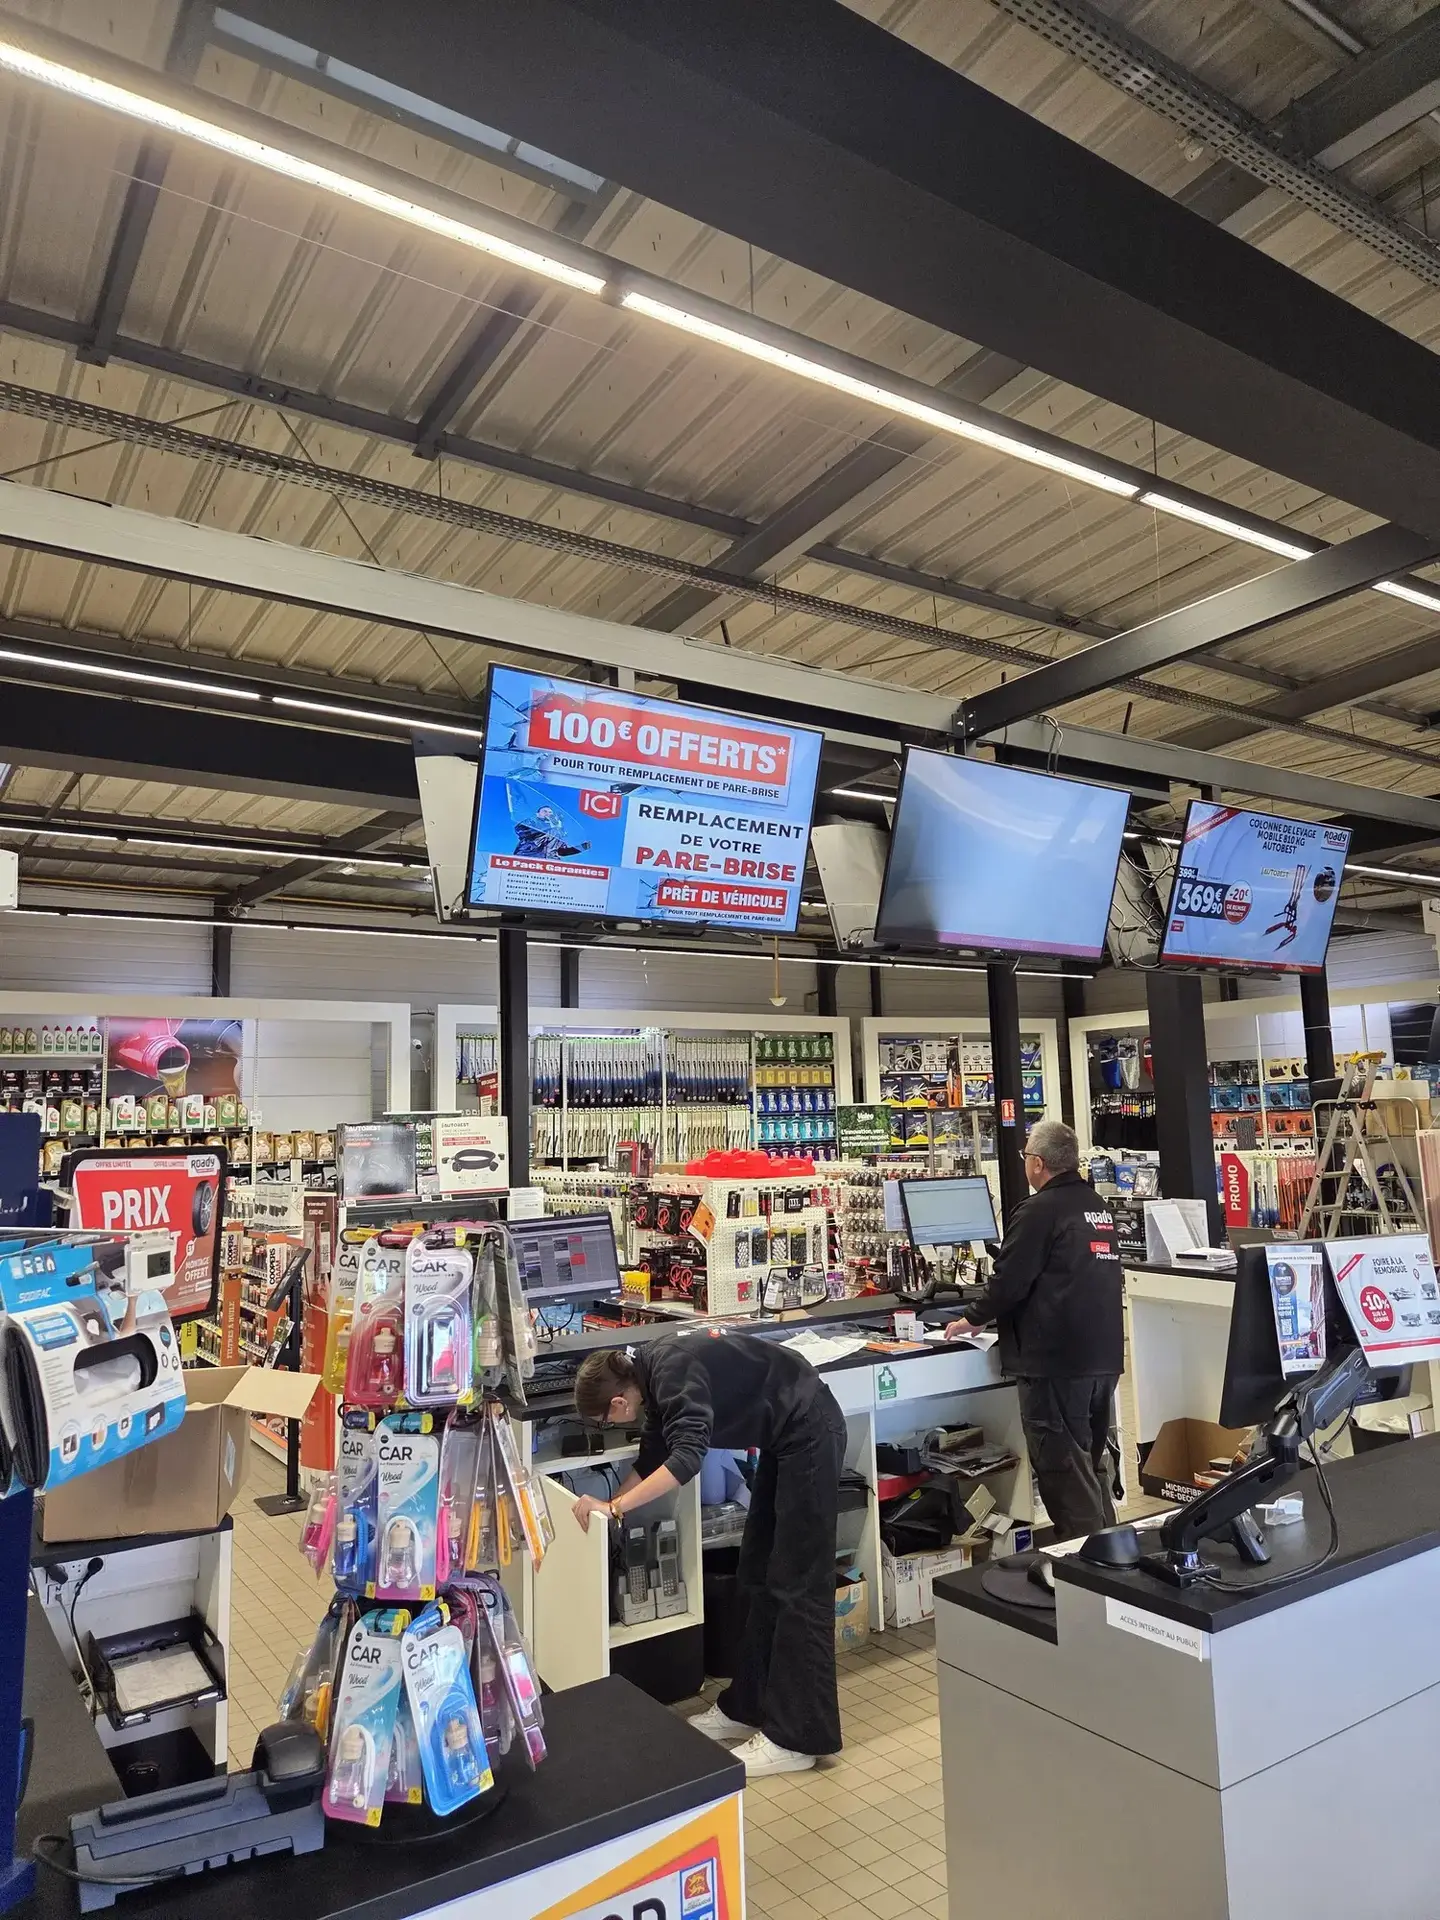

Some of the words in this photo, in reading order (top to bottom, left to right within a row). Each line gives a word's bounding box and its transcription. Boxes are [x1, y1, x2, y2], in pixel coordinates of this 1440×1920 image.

[544, 708, 633, 748] 100€
[553, 756, 584, 771] POUR
[587, 760, 616, 775] TOUT
[618, 766, 704, 788] REMPLACEMENT
[707, 778, 720, 790] DE
[722, 781, 780, 799] PARE-BRISE
[584, 793, 618, 815] ICI
[638, 804, 804, 840] REMPLACEMENT
[1250, 818, 1283, 834] COLONNE
[1284, 825, 1292, 834] DE
[1292, 826, 1317, 839] LEVAGE
[680, 833, 704, 848] DE
[709, 838, 762, 854] VOTRE
[1257, 830, 1284, 843] MOBILE
[1284, 834, 1295, 844] 810
[1296, 837, 1306, 846] KG
[1262, 842, 1298, 854] AUTOBEST
[496, 858, 510, 867] Le
[512, 860, 544, 870] Pack
[546, 864, 605, 877] Garanties
[636, 846, 796, 882] PARE-BRISE
[662, 885, 698, 902] PRÊT
[702, 890, 719, 904] DE
[722, 890, 783, 909] VÉHICULE
[700, 911, 742, 920] REMPLACEMENT
[1228, 1164, 1241, 1210] PROMO
[102, 1185, 172, 1230] PRIX
[1084, 1210, 1113, 1227] Roady
[340, 1254, 359, 1268] CA
[364, 1260, 400, 1273] CAR
[412, 1260, 447, 1273] CAR
[1372, 1257, 1390, 1266] FOIRE
[184, 1266, 209, 1282] OFFERT
[1374, 1266, 1408, 1274] REMORQUE
[1362, 1294, 1390, 1310] -10%
[342, 1440, 364, 1456] CAR
[379, 1446, 413, 1460] CAR
[380, 1470, 403, 1482] Wood
[1120, 1615, 1138, 1626] ACCES
[1139, 1622, 1165, 1636] INTERDIT
[1176, 1636, 1198, 1649] PUBLIC
[351, 1645, 382, 1664] CAR
[408, 1643, 440, 1670] CAR
[348, 1673, 369, 1685] Wood
